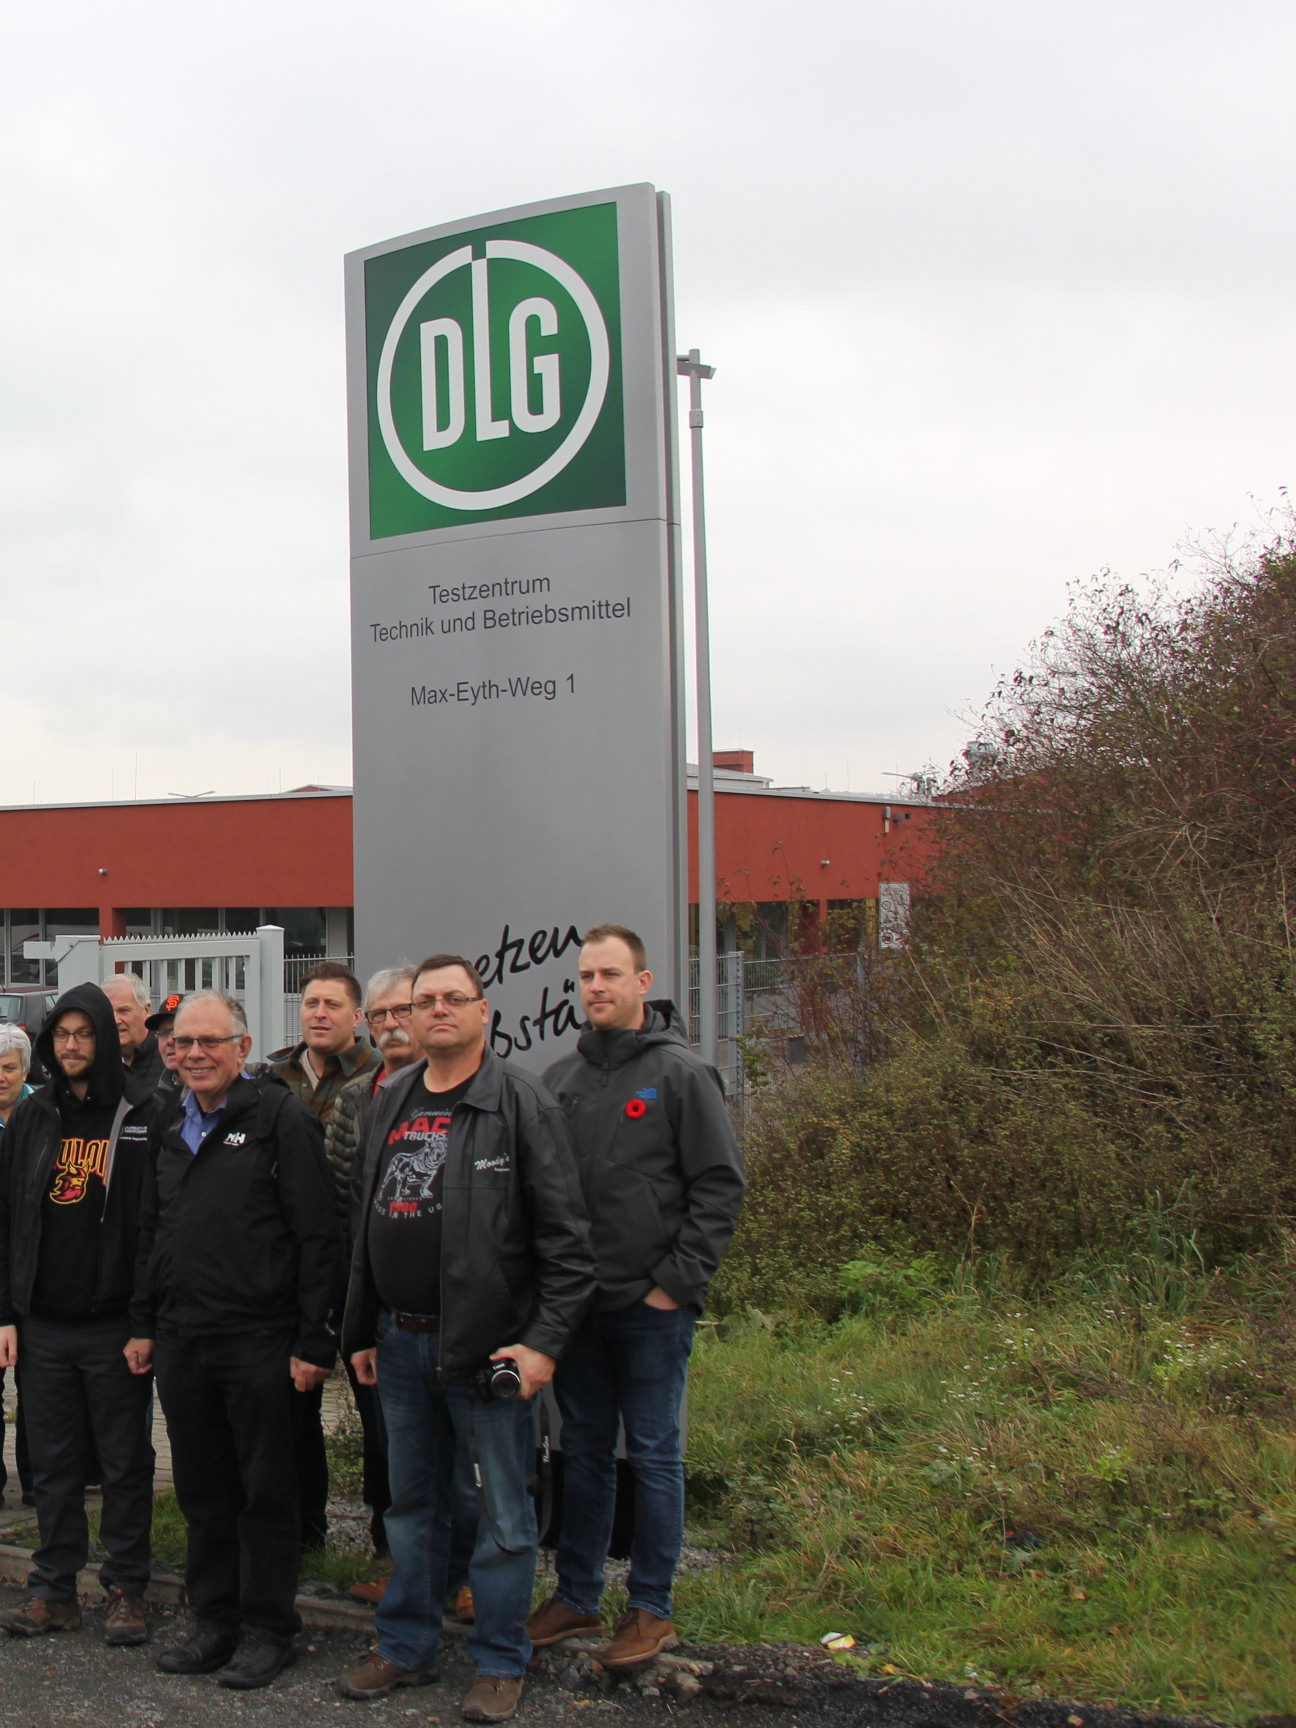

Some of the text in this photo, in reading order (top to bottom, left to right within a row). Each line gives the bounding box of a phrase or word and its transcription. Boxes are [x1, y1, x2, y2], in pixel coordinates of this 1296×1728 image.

[420, 257, 561, 452] DLG
[429, 577, 551, 604] Testzentrum
[370, 597, 631, 642] Technik und Betriebsmittel
[411, 673, 575, 706] Max-Eyth-Weg 1
[474, 924, 584, 989] etzen
[388, 1116, 451, 1145] MAC
